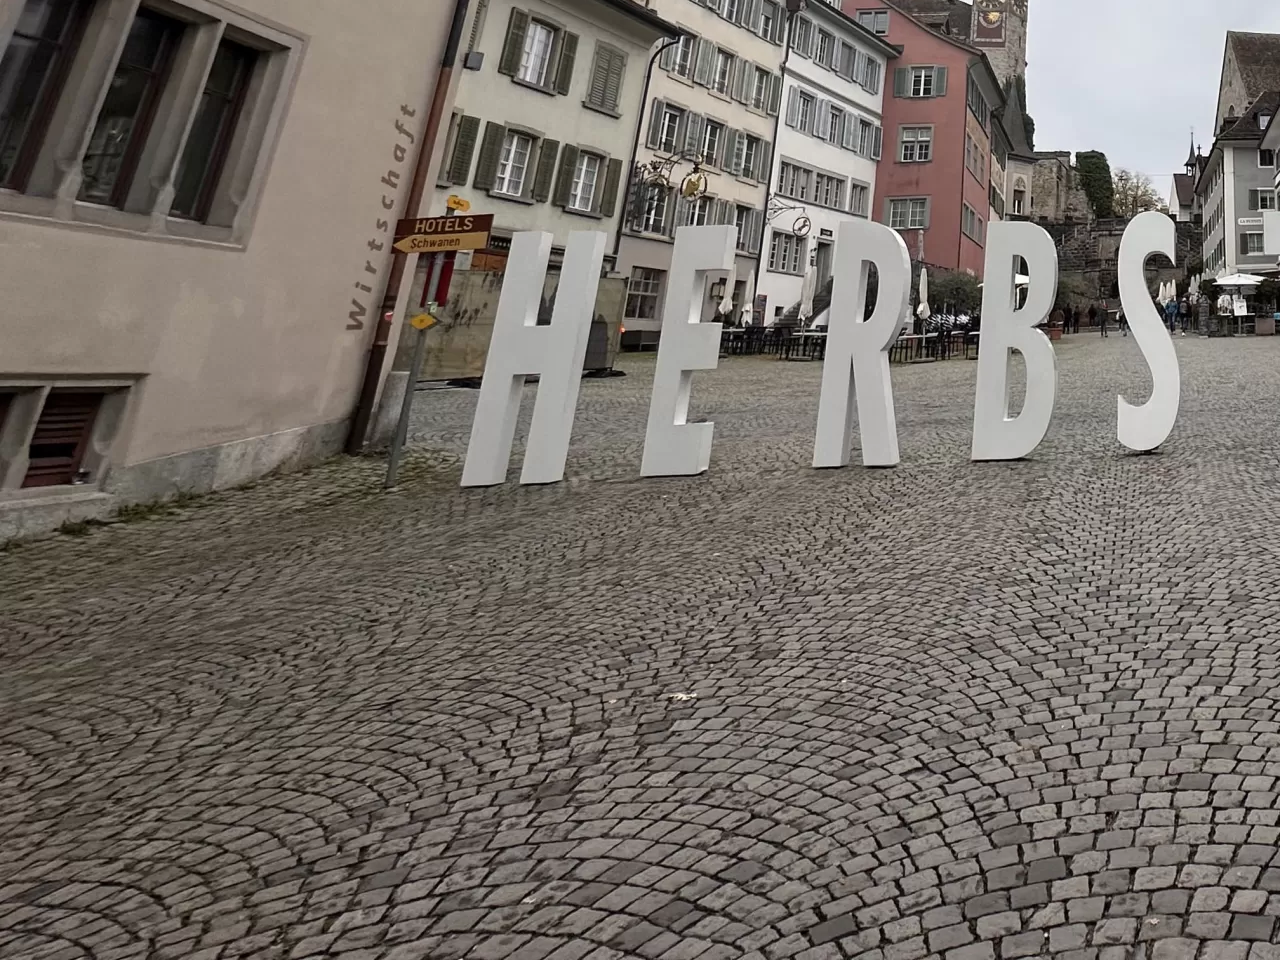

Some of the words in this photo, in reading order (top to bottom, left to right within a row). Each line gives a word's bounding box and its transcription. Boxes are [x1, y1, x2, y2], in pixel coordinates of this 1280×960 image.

[346, 103, 417, 332] Wirtschaft
[414, 217, 474, 234] HOTELS
[410, 236, 461, 250] Schwanen
